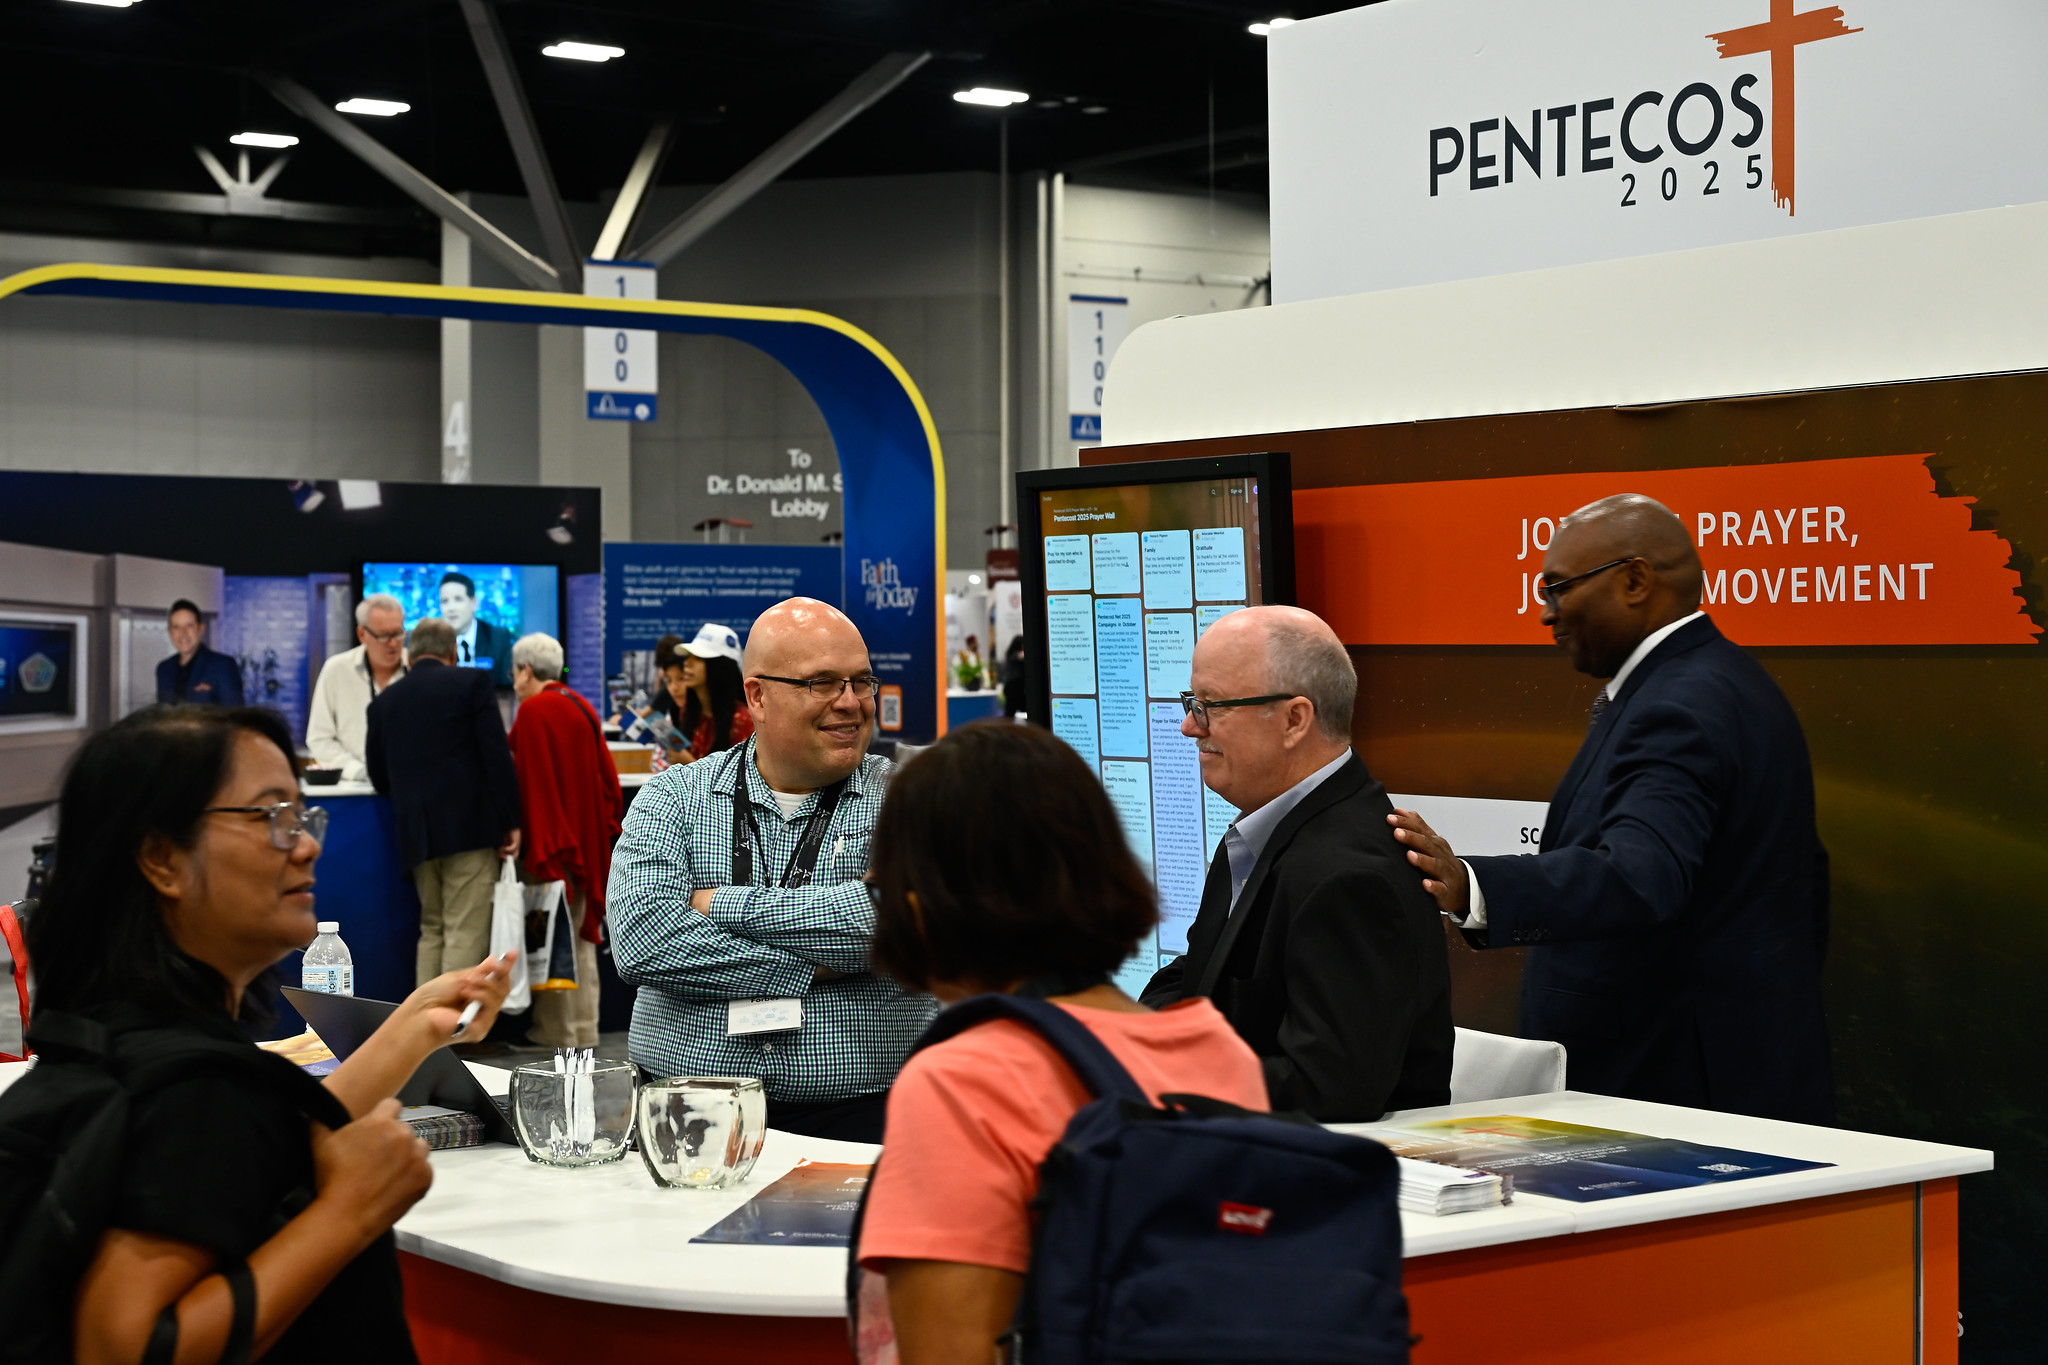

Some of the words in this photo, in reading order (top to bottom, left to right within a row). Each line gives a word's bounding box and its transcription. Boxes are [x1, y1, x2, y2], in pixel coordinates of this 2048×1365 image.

[1620, 154, 1764, 207] 2025
[444, 401, 469, 457] 4
[787, 448, 812, 469] To
[707, 474, 734, 495] Dr.
[736, 473, 802, 494] Donald
[805, 472, 830, 493] M.
[770, 498, 829, 522] Lobby
[1090, 513, 1104, 521] Prayer
[1517, 517, 1567, 560] JO
[1697, 505, 1859, 548] PRAYER,
[860, 557, 899, 585] Faith
[1700, 563, 1934, 605] MOVEMENT
[666, 587, 680, 596] and
[875, 582, 919, 616] Today
